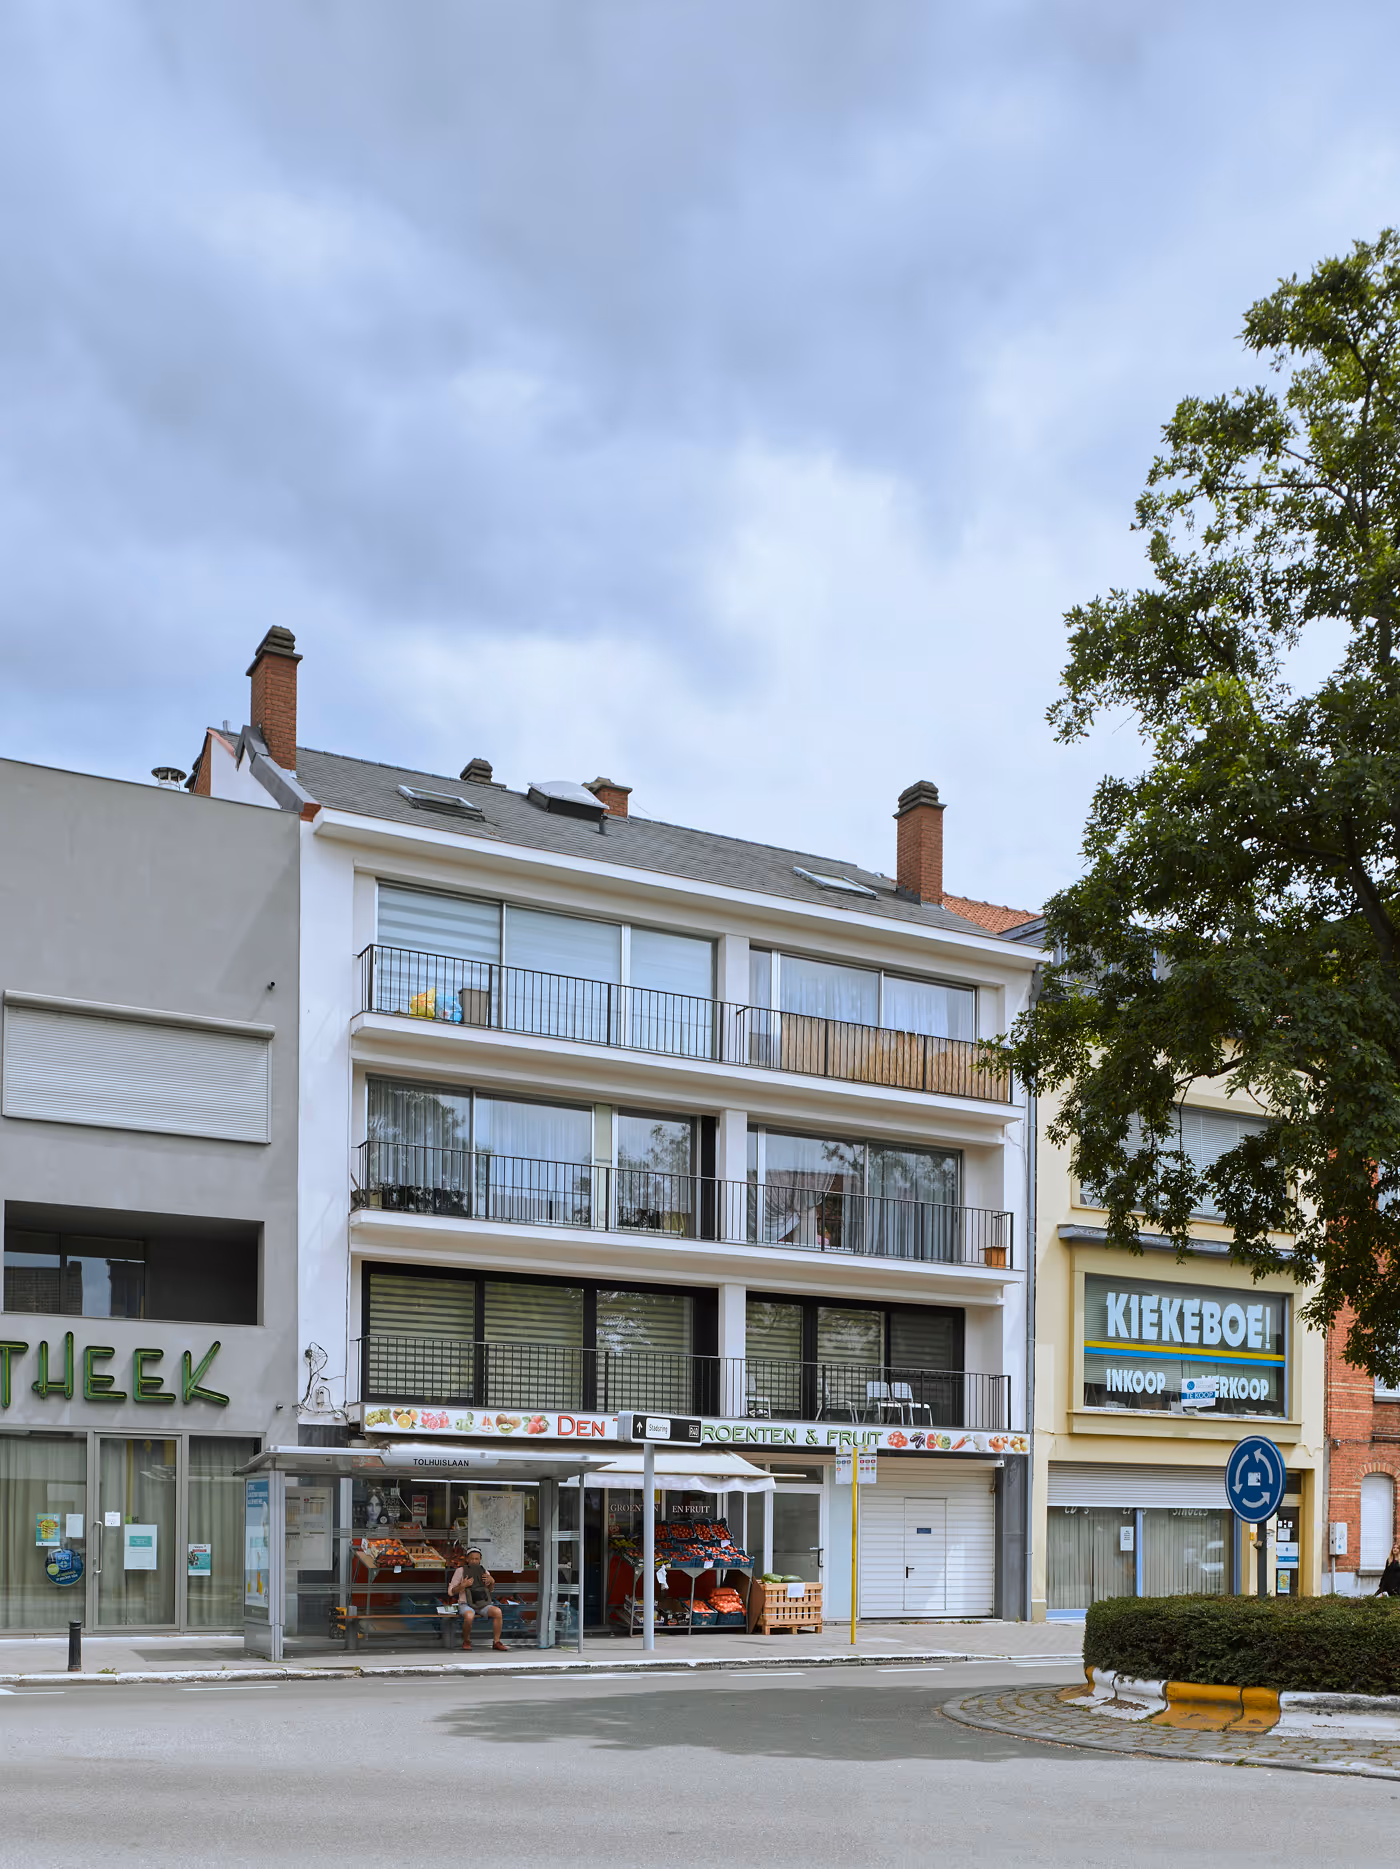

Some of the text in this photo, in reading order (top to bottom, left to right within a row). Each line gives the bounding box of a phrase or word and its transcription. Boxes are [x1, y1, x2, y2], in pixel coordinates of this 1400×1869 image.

[1106, 1292, 1271, 1349] KIEKEBOE!
[1106, 1369, 1269, 1401] INKOOP ERKOOP
[1195, 1391, 1213, 1399] KOOP
[649, 1423, 668, 1435] Stadsring
[702, 1424, 797, 1444] ROENTEN
[806, 1429, 818, 1445] &
[827, 1430, 883, 1446] FRUIT
[413, 1459, 470, 1467] TOLHUISLAAN
